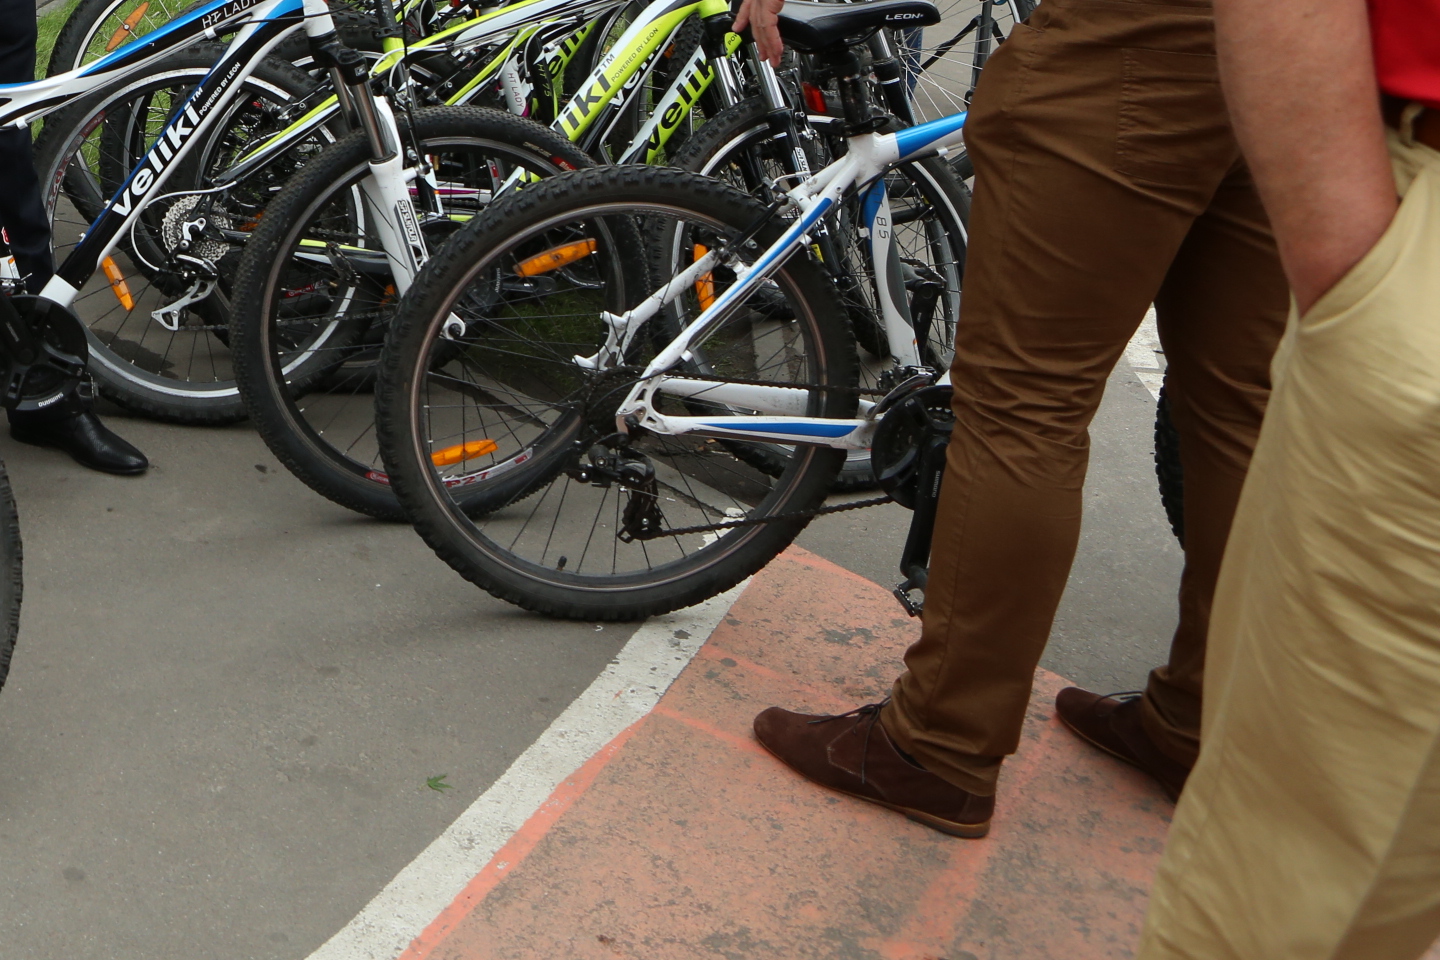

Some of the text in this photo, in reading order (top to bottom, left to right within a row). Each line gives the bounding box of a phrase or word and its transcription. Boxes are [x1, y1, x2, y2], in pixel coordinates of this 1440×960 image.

[201, 10, 222, 29] HT
[611, 27, 660, 83] POWERED BY LEON
[198, 62, 242, 116] POWERED BY LEON
[511, 86, 525, 108] LADY
[111, 101, 201, 217] veliki
